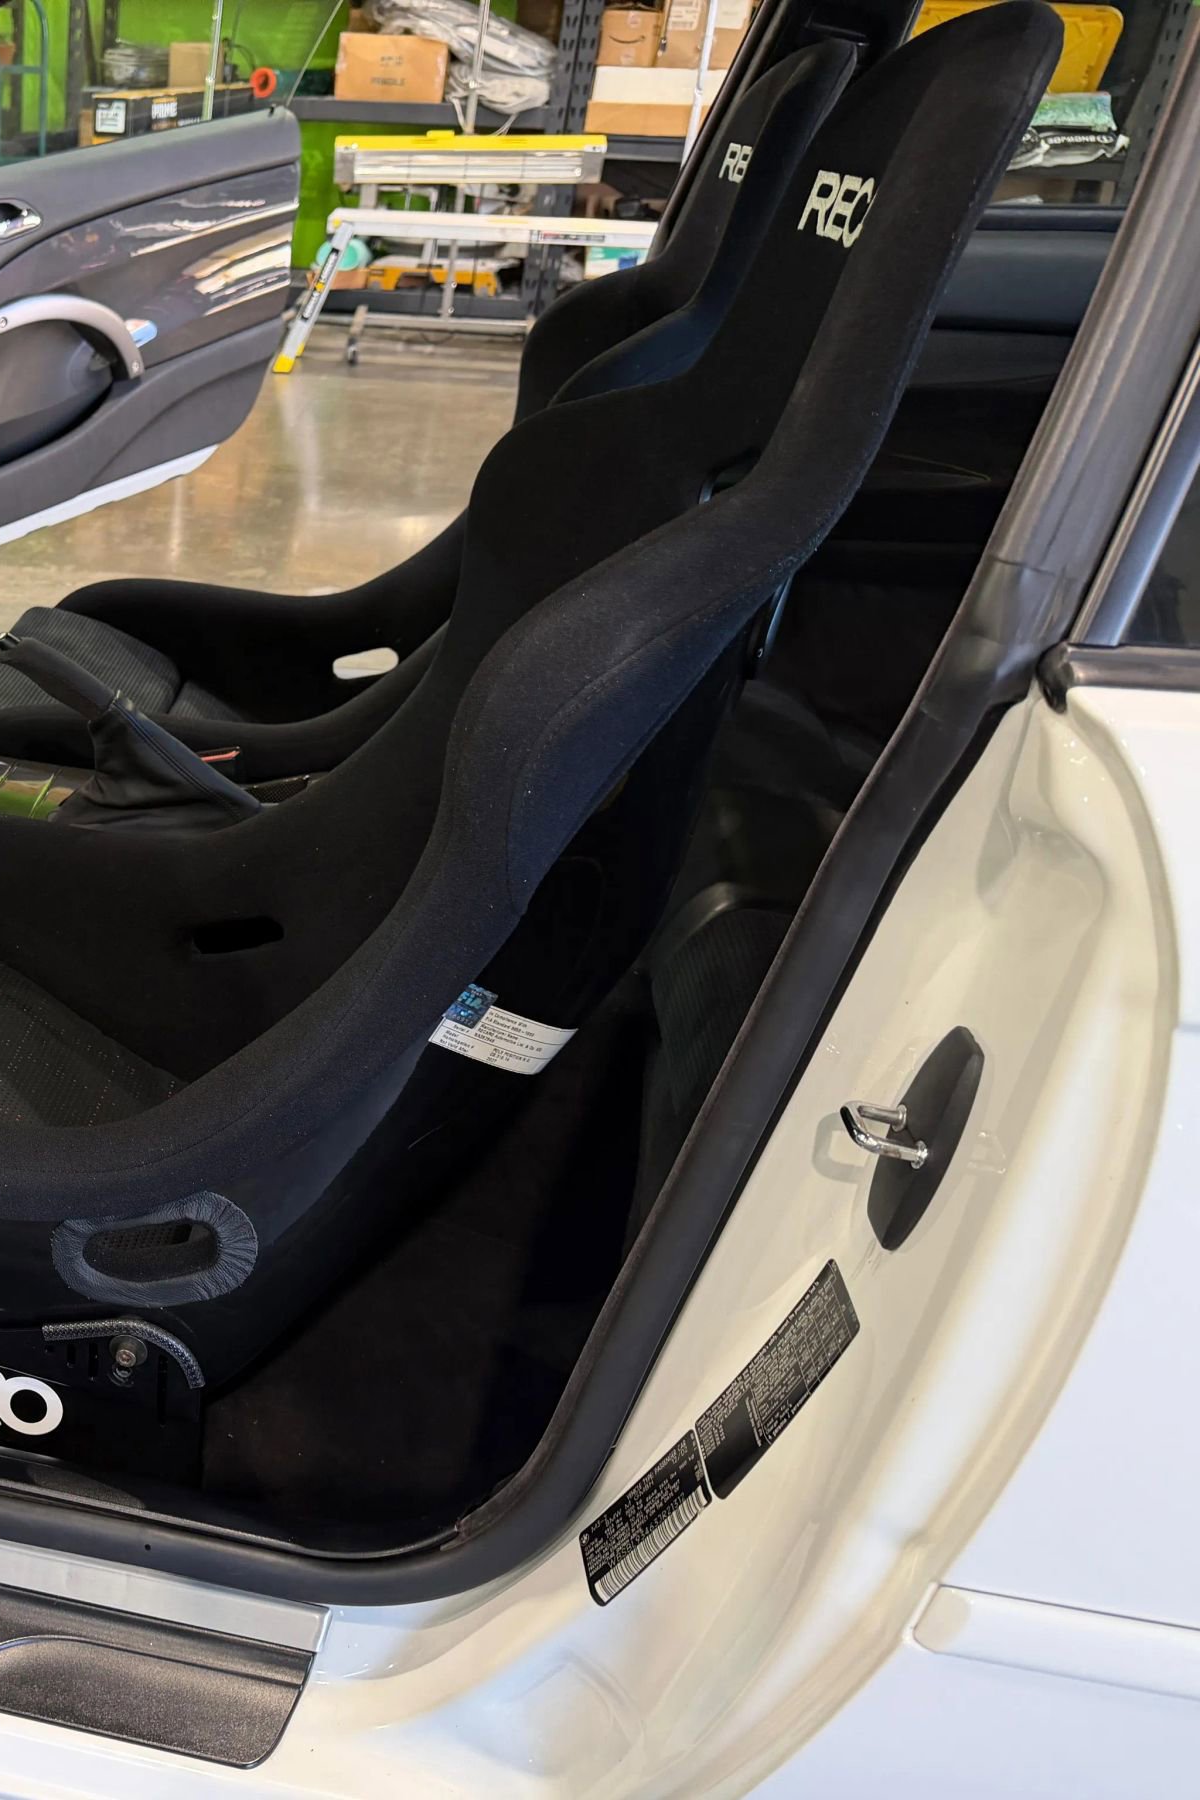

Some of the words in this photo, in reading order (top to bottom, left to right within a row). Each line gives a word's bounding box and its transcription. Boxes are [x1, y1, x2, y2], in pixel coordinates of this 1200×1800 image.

[797, 169, 876, 249] REC
[492, 1018, 511, 1029] Standard
[477, 1027, 494, 1036] RECARO
